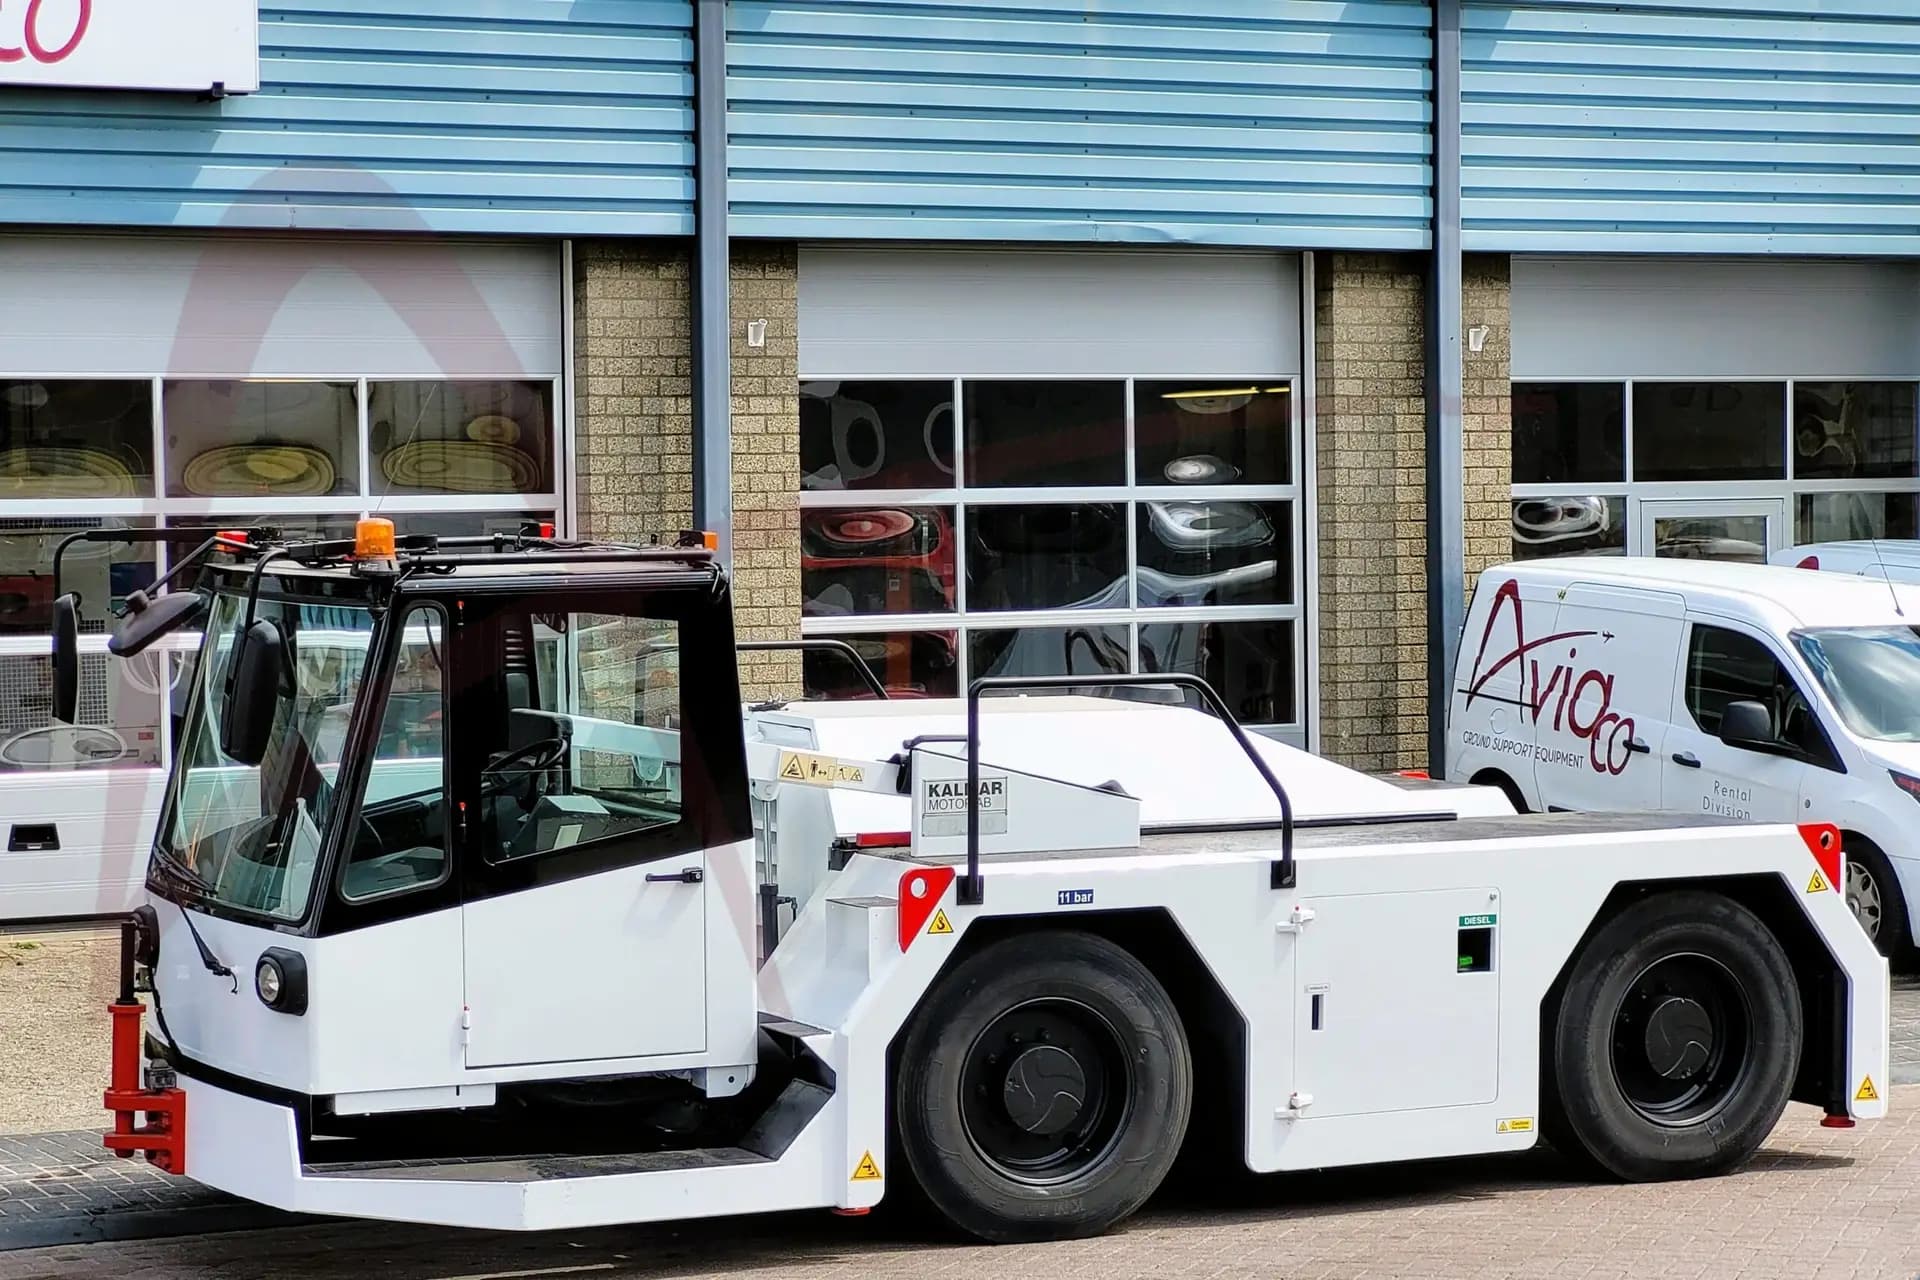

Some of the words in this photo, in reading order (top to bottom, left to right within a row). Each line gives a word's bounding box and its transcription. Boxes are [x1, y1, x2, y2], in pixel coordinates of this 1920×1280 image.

[1465, 578, 1635, 775] Aviaco
[1462, 730, 1491, 749] GROUND
[1491, 737, 1534, 758] SUPPORT
[1534, 745, 1585, 769] EQUIPMENT
[928, 781, 1003, 798] KALAR
[1714, 780, 1752, 802] Rental
[1702, 795, 1751, 821] Division
[1059, 891, 1070, 904] 11
[1073, 890, 1092, 903] bar
[1464, 915, 1492, 925] DIESEL
